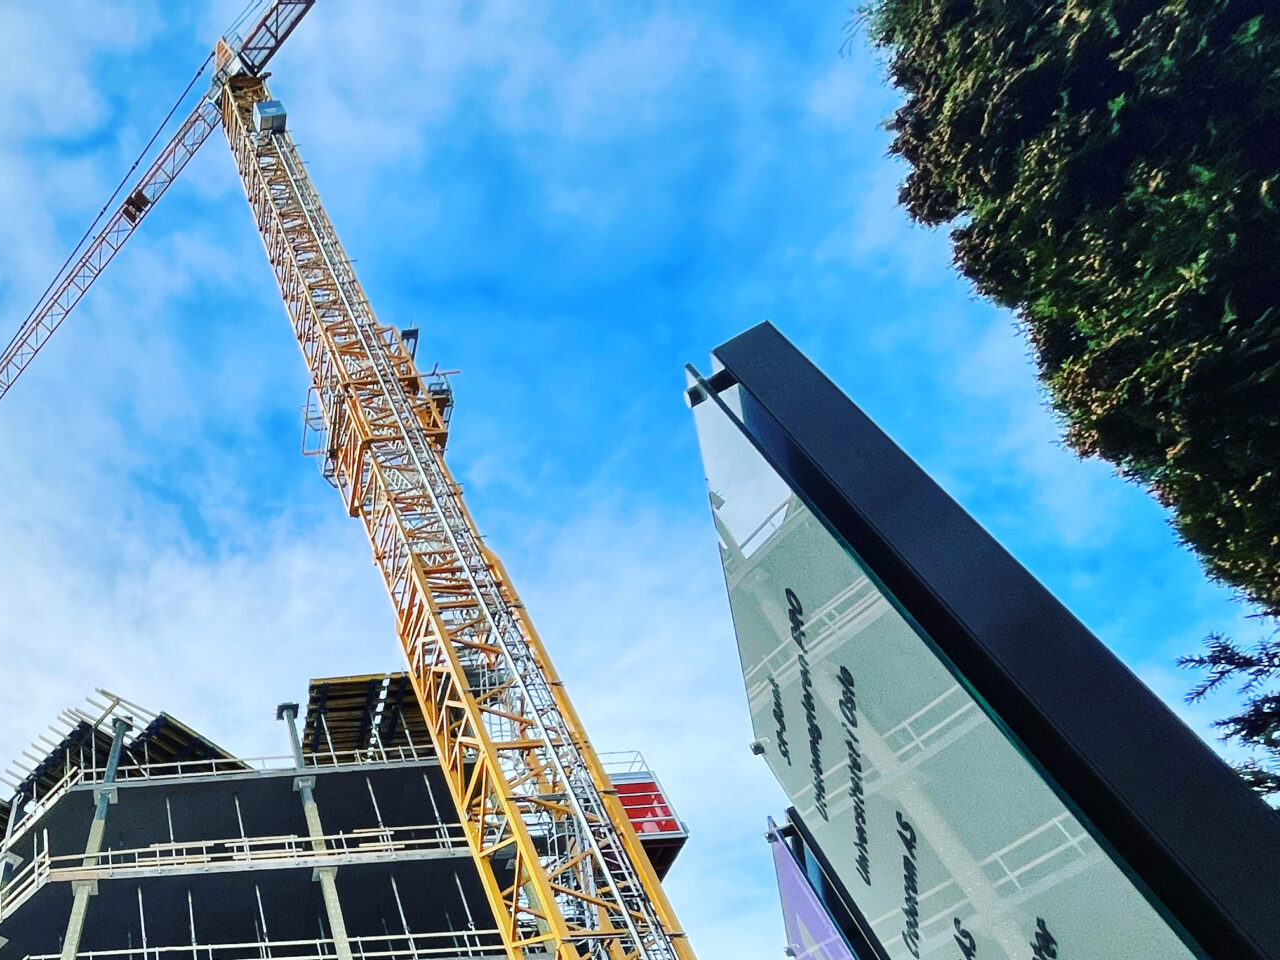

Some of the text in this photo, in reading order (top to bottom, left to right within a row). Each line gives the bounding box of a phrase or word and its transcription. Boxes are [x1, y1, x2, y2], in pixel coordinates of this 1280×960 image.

[836, 665, 859, 729] Oslo
[844, 738, 872, 887] Universitetet
[895, 810, 917, 861] AS
